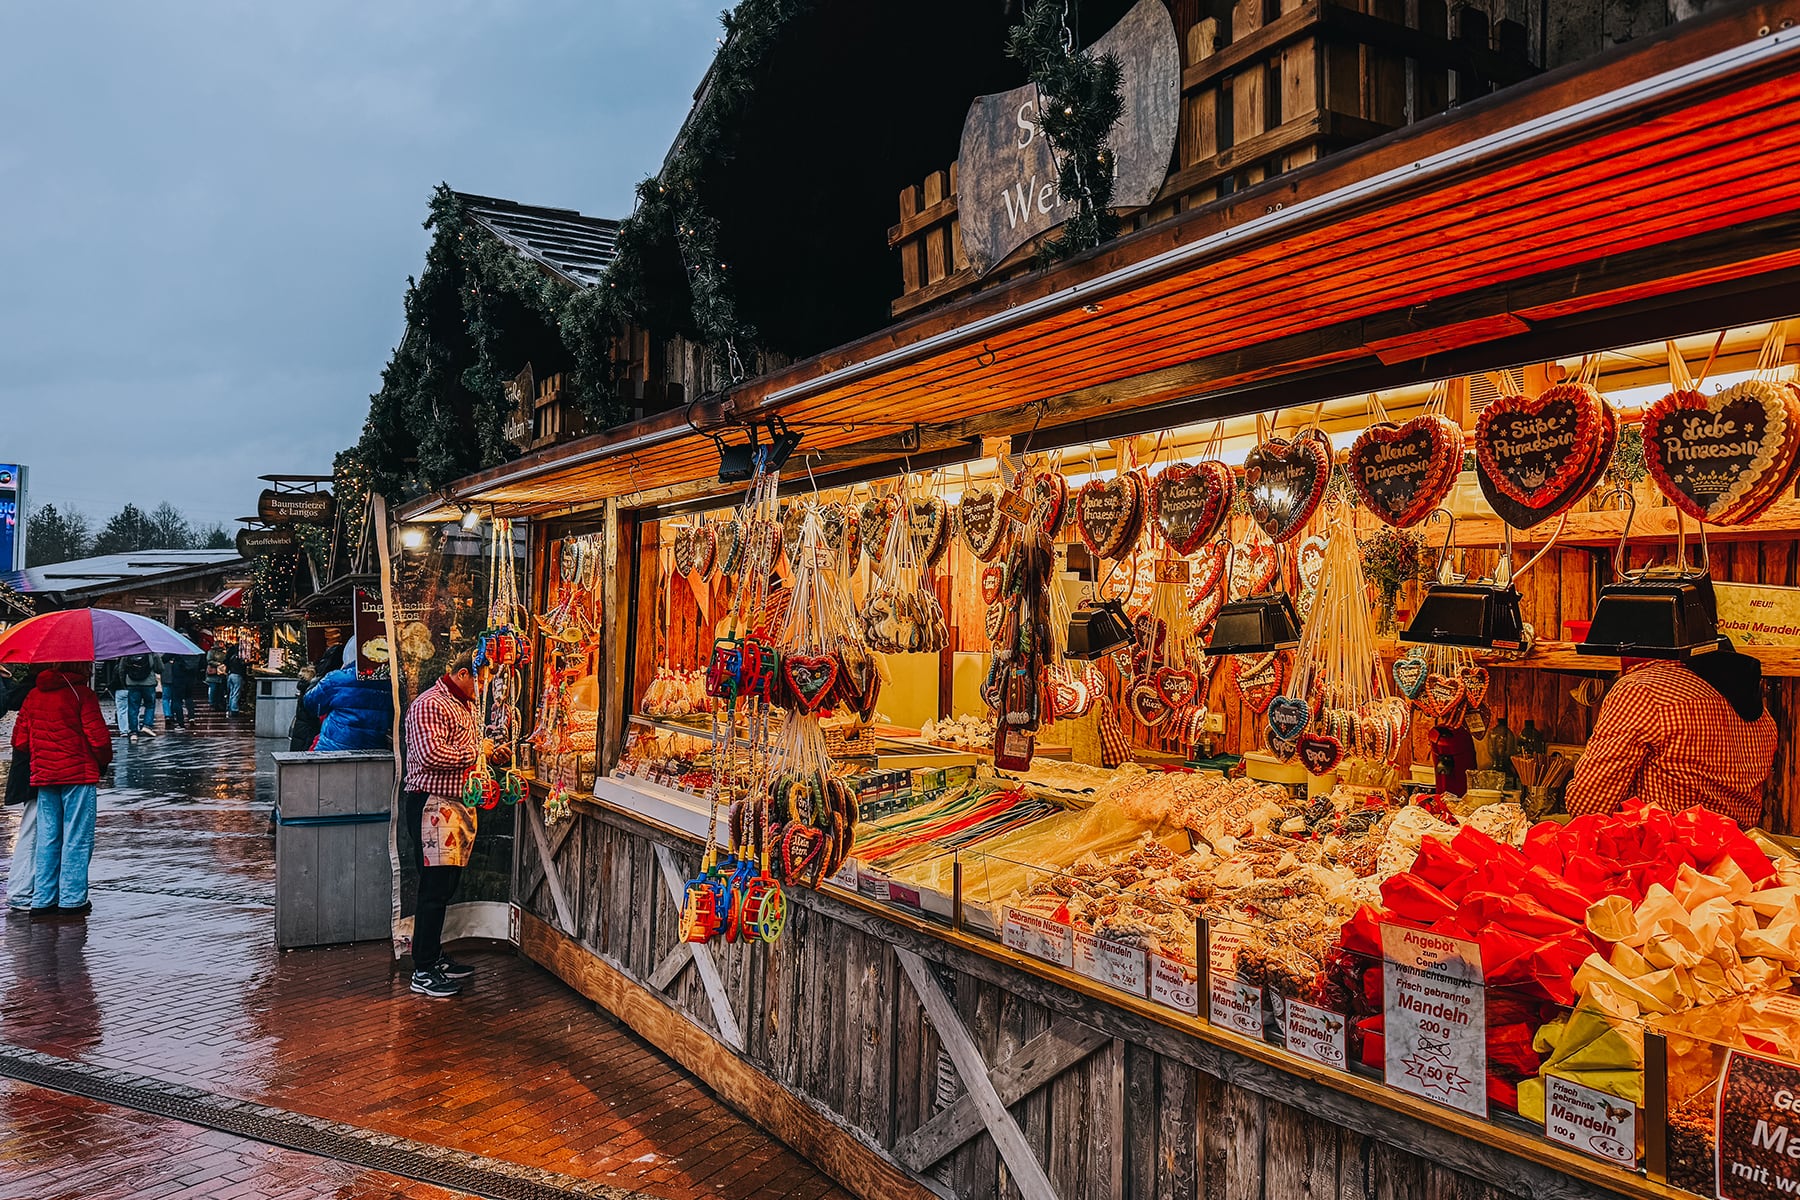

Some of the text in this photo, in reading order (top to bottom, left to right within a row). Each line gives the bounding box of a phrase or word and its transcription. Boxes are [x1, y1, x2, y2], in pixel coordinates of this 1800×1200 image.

[1510, 416, 1561, 441] Süße
[1681, 412, 1738, 440] Liebe
[1493, 429, 1575, 460] Prinzessin
[1662, 437, 1760, 464] Prinzessin
[1364, 456, 1430, 485] Prinzessin
[271, 499, 326, 510] Baumstrietzel
[289, 508, 319, 518] Langos
[245, 537, 292, 546] Kartoffelwirbel
[1749, 600, 1774, 609] NEU!!
[1715, 618, 1750, 631] Dubai
[1009, 909, 1042, 928] Gebrannte
[1043, 919, 1064, 935] Nüsse
[1075, 932, 1098, 948] Aroma
[1099, 939, 1132, 959] Mandeln
[1403, 931, 1455, 953] Angebot
[1422, 949, 1438, 959] zum
[1160, 960, 1180, 974] Dubai
[1394, 962, 1472, 989] Weihnachtsmarkt
[1155, 969, 1184, 987] Mandeln
[1212, 976, 1228, 988] Frisch
[1212, 984, 1238, 998] gebrannte
[1395, 978, 1471, 1005] Frisch gebrannte
[1212, 991, 1251, 1015] Mandeln
[1289, 1003, 1307, 1014] Frisch
[1397, 992, 1469, 1025] Mandeln
[1290, 1011, 1318, 1025] gebrannte
[1289, 1019, 1333, 1044] Mandeln
[1419, 1018, 1451, 1039] 200 g
[1301, 1040, 1307, 1049] g
[1334, 1049, 1341, 1059] €
[1445, 1072, 1455, 1085] €
[1552, 1082, 1578, 1098] Frisch
[1552, 1091, 1596, 1112] gebrannte
[1550, 1103, 1617, 1138] Mandeln
[1553, 1125, 1576, 1141] 100 g
[1599, 1140, 1625, 1157] 4,- €
[1731, 1161, 1770, 1186] mit
